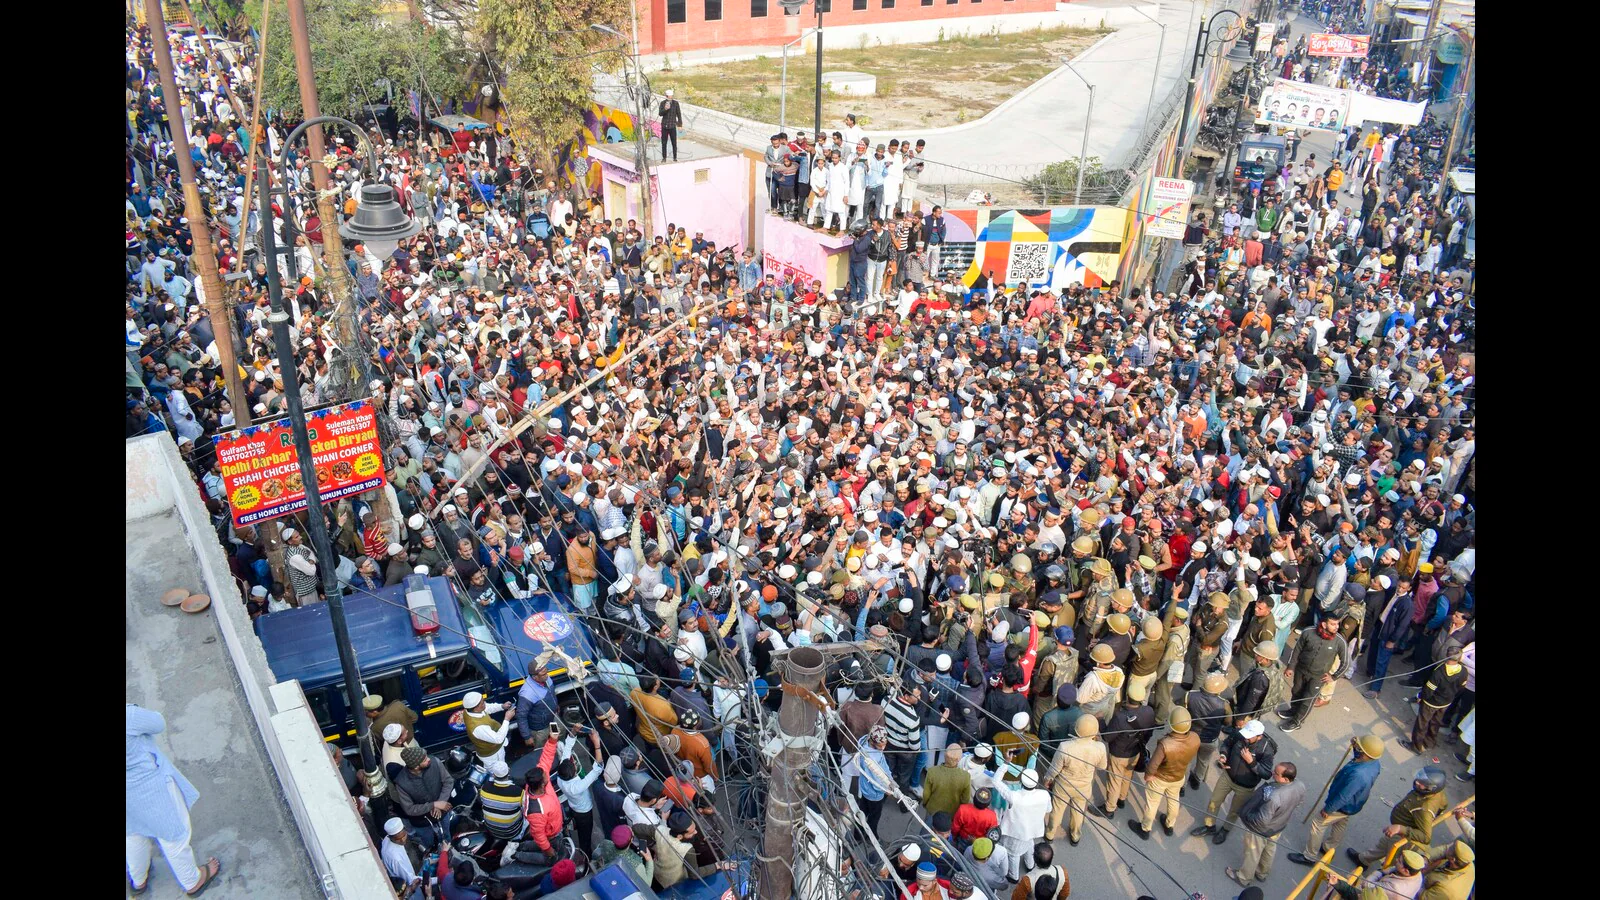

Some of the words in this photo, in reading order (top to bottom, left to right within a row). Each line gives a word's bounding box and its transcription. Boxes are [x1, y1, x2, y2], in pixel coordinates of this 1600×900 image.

[1159, 180, 1185, 189] REENA
[326, 418, 355, 430] Suleman
[356, 413, 372, 422] Khan
[331, 421, 370, 436] 7617651307
[220, 445, 246, 456] Gulfam
[247, 441, 266, 450] Khan
[222, 460, 250, 478] Delhi
[252, 450, 291, 470] Darbar
[338, 427, 376, 447] Biryani
[232, 472, 262, 486] SHAHI
[340, 442, 374, 458] CORNER
[238, 497, 257, 506] DELIVERY
[240, 513, 257, 524] FREE
[258, 507, 278, 518] HOME
[280, 500, 307, 512] DELIVER
[343, 484, 364, 495] ORDER
[365, 479, 381, 488] 100/-
